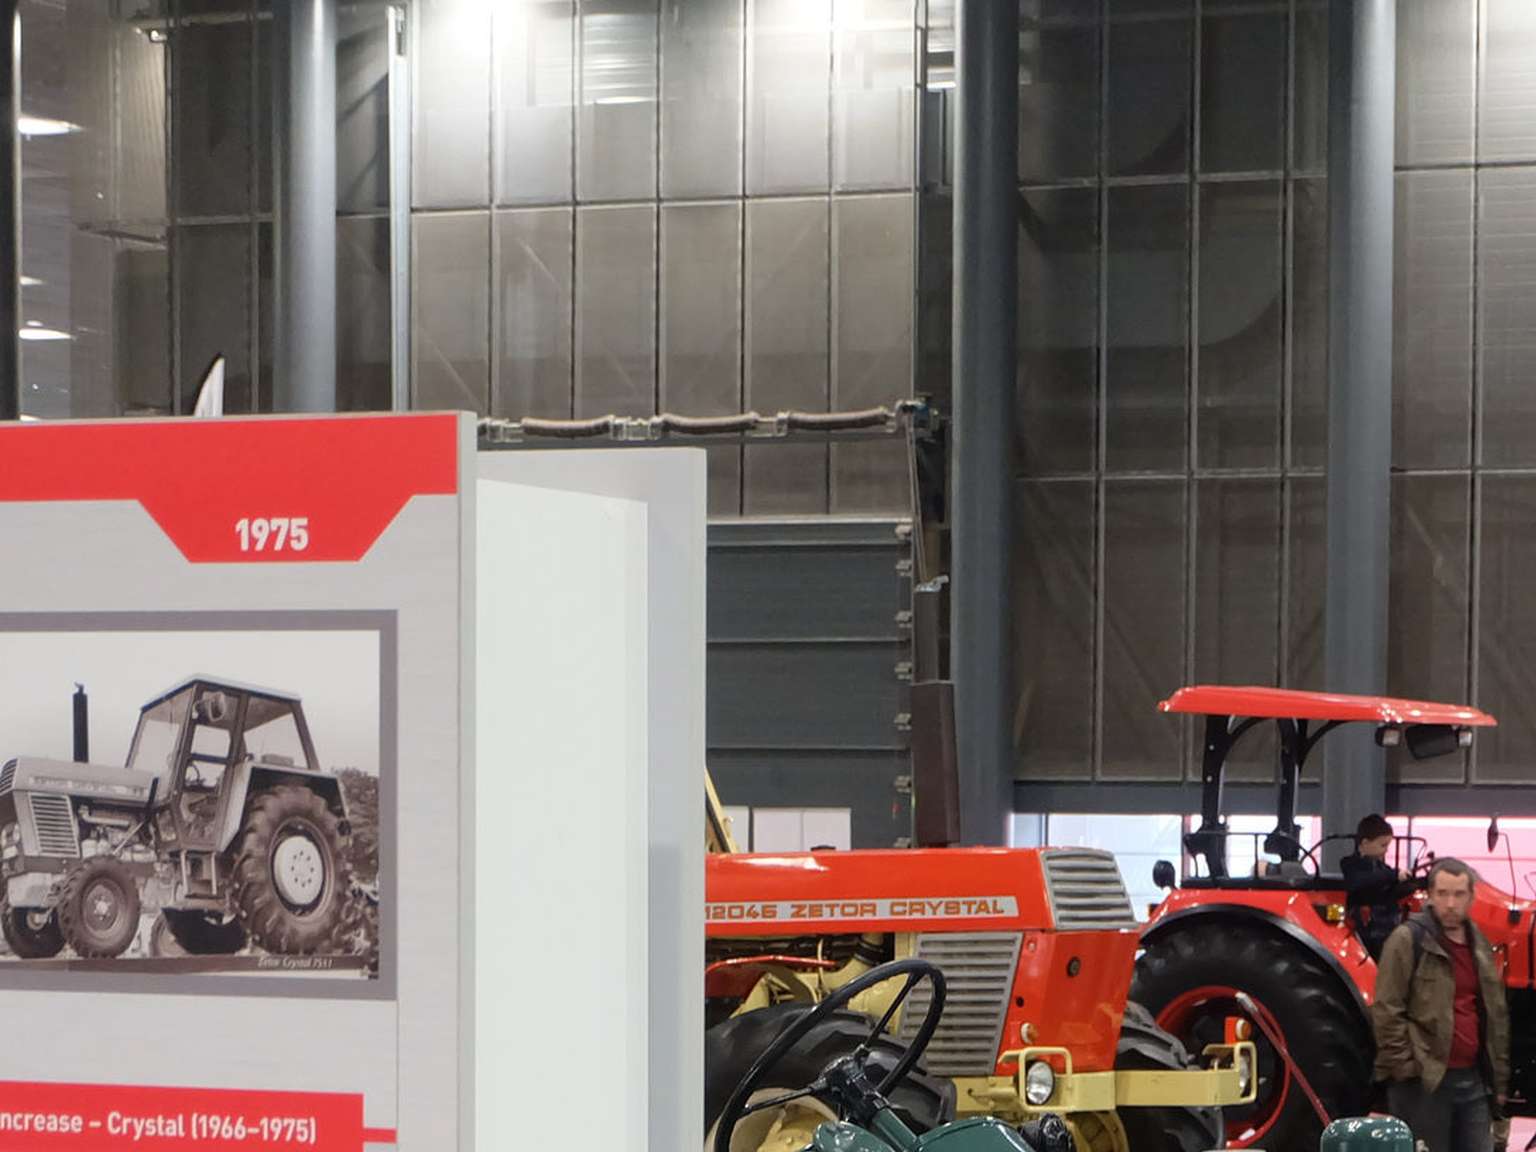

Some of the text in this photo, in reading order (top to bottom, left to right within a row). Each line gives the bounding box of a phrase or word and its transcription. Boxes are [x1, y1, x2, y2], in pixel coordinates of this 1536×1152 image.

[235, 517, 309, 551] 1975
[790, 902, 878, 919] ZETOR
[890, 899, 1006, 916] CRYSTAL
[107, 1110, 185, 1141] Crystal
[191, 1114, 317, 1145] (1966–1975)
